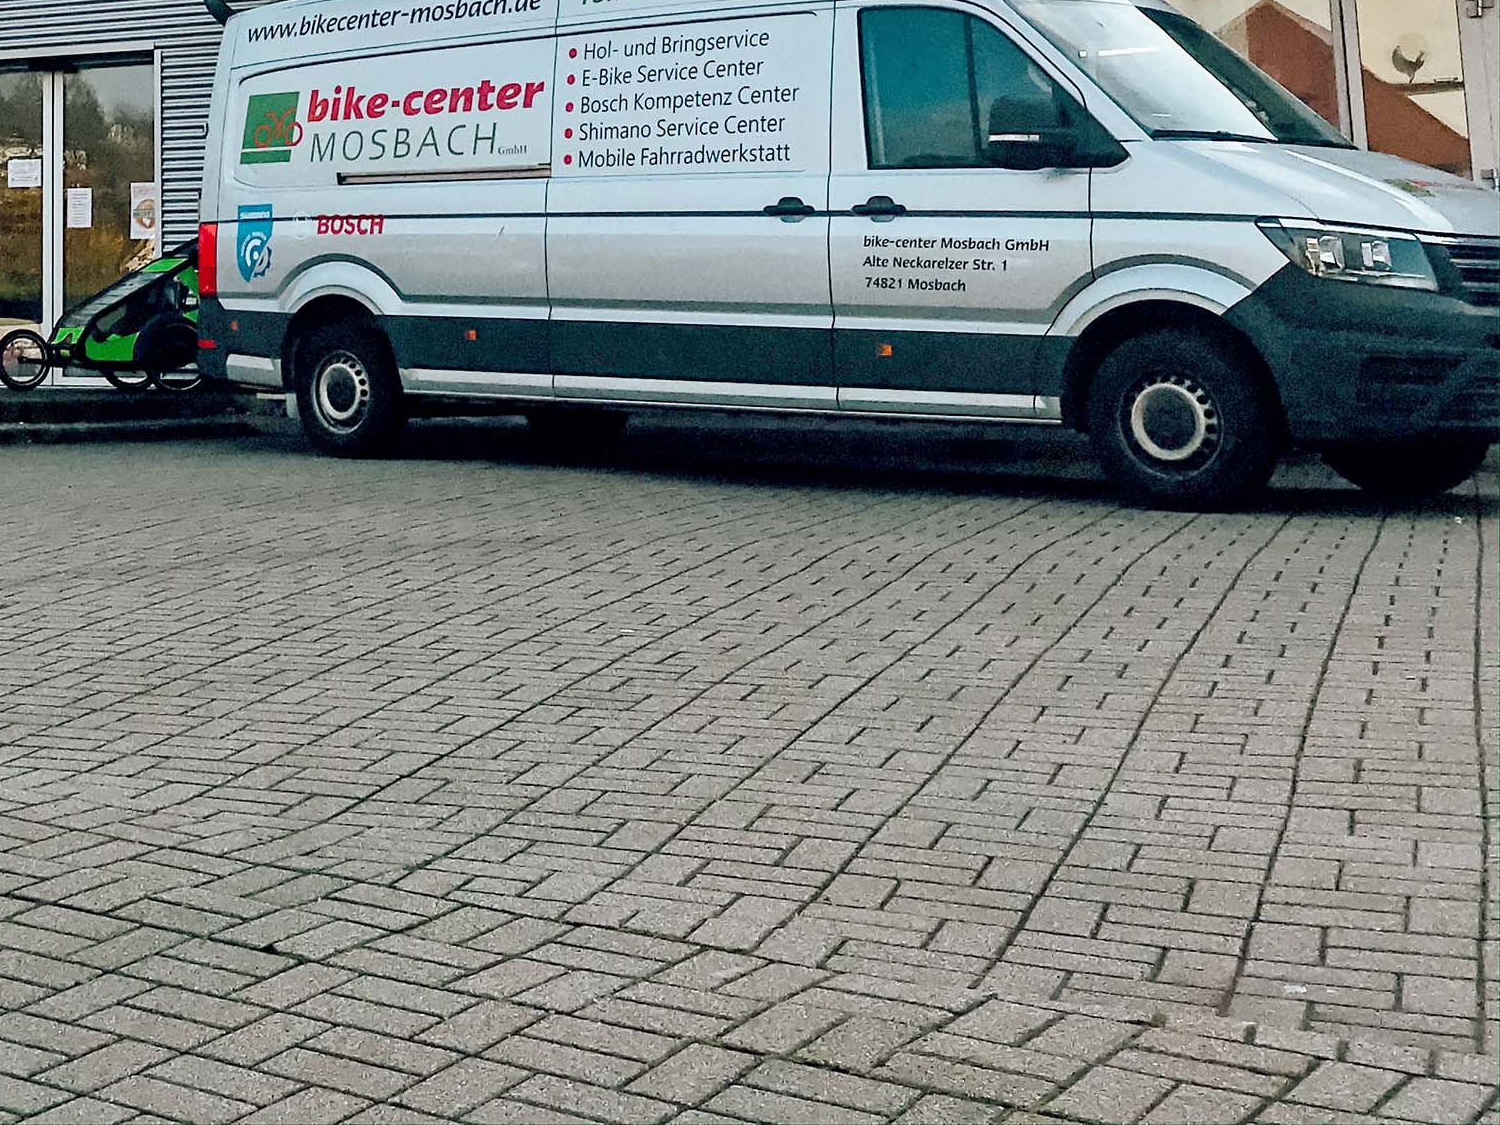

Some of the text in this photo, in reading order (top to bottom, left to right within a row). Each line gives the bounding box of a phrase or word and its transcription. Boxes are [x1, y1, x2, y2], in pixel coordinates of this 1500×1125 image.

[584, 29, 769, 60] Hol- und Bringservice
[582, 60, 764, 86] E-Bike Service Center
[307, 80, 545, 122] bike-center
[581, 86, 800, 114] Bosch Kompetenz Center
[579, 115, 785, 141] Shimano Service Center
[310, 122, 527, 162] MOSBACH GmbH
[578, 143, 790, 168] Mobile Fahrradwerkstatt
[317, 214, 384, 235] BOSCH
[863, 236, 1049, 251] bike-center Mosbach GmbH
[863, 255, 1007, 271] Alte Neckarelzer Str. 1
[865, 277, 966, 291] 74821 Mosbach
